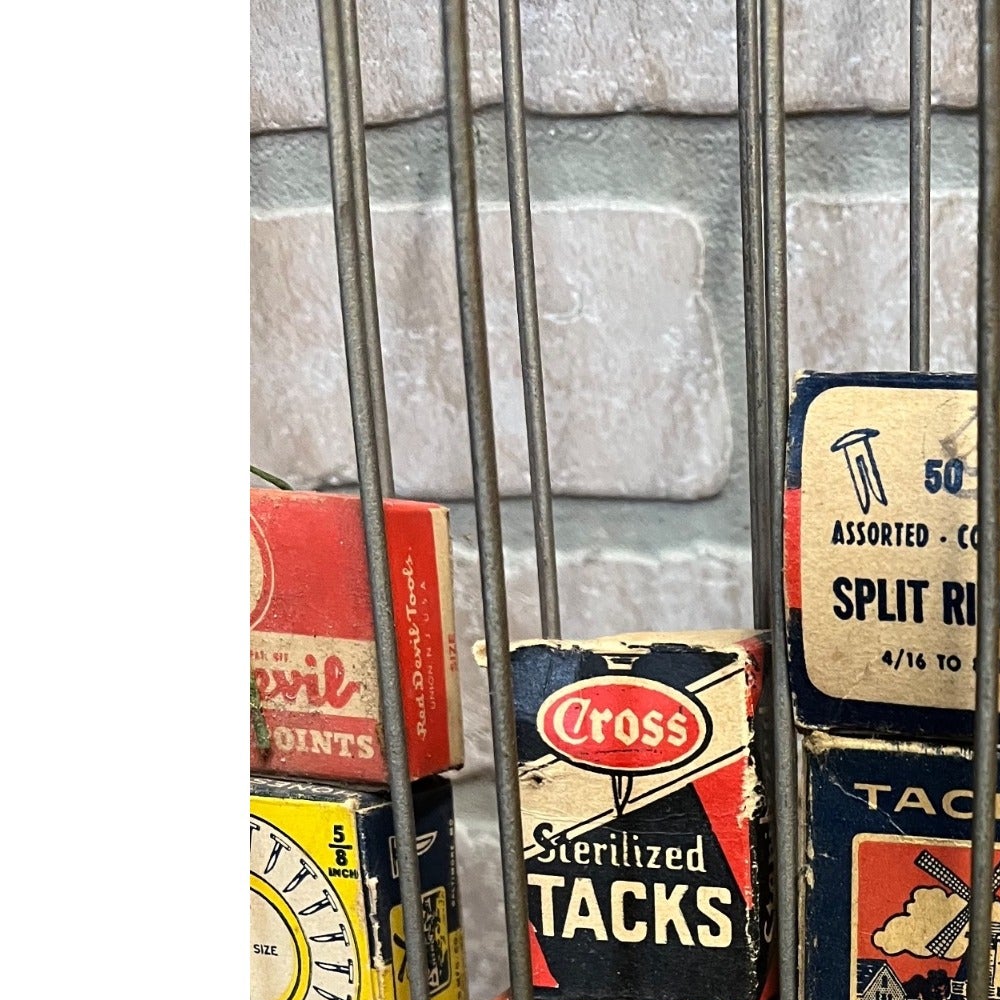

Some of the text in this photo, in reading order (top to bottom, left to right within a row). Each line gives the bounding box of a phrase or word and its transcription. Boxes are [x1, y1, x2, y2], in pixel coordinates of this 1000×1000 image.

[925, 459, 964, 494] 50
[831, 520, 929, 548] ASSORTED
[832, 576, 929, 626] SPLIT
[402, 554, 427, 741] Red Devil Tools
[882, 648, 927, 671] 4/16
[937, 653, 961, 673] TO
[271, 726, 374, 759] OINTS
[553, 698, 688, 748] Cross
[534, 822, 707, 873] Sterilized
[527, 873, 733, 948] TACKS
[253, 944, 279, 956] SIZE
